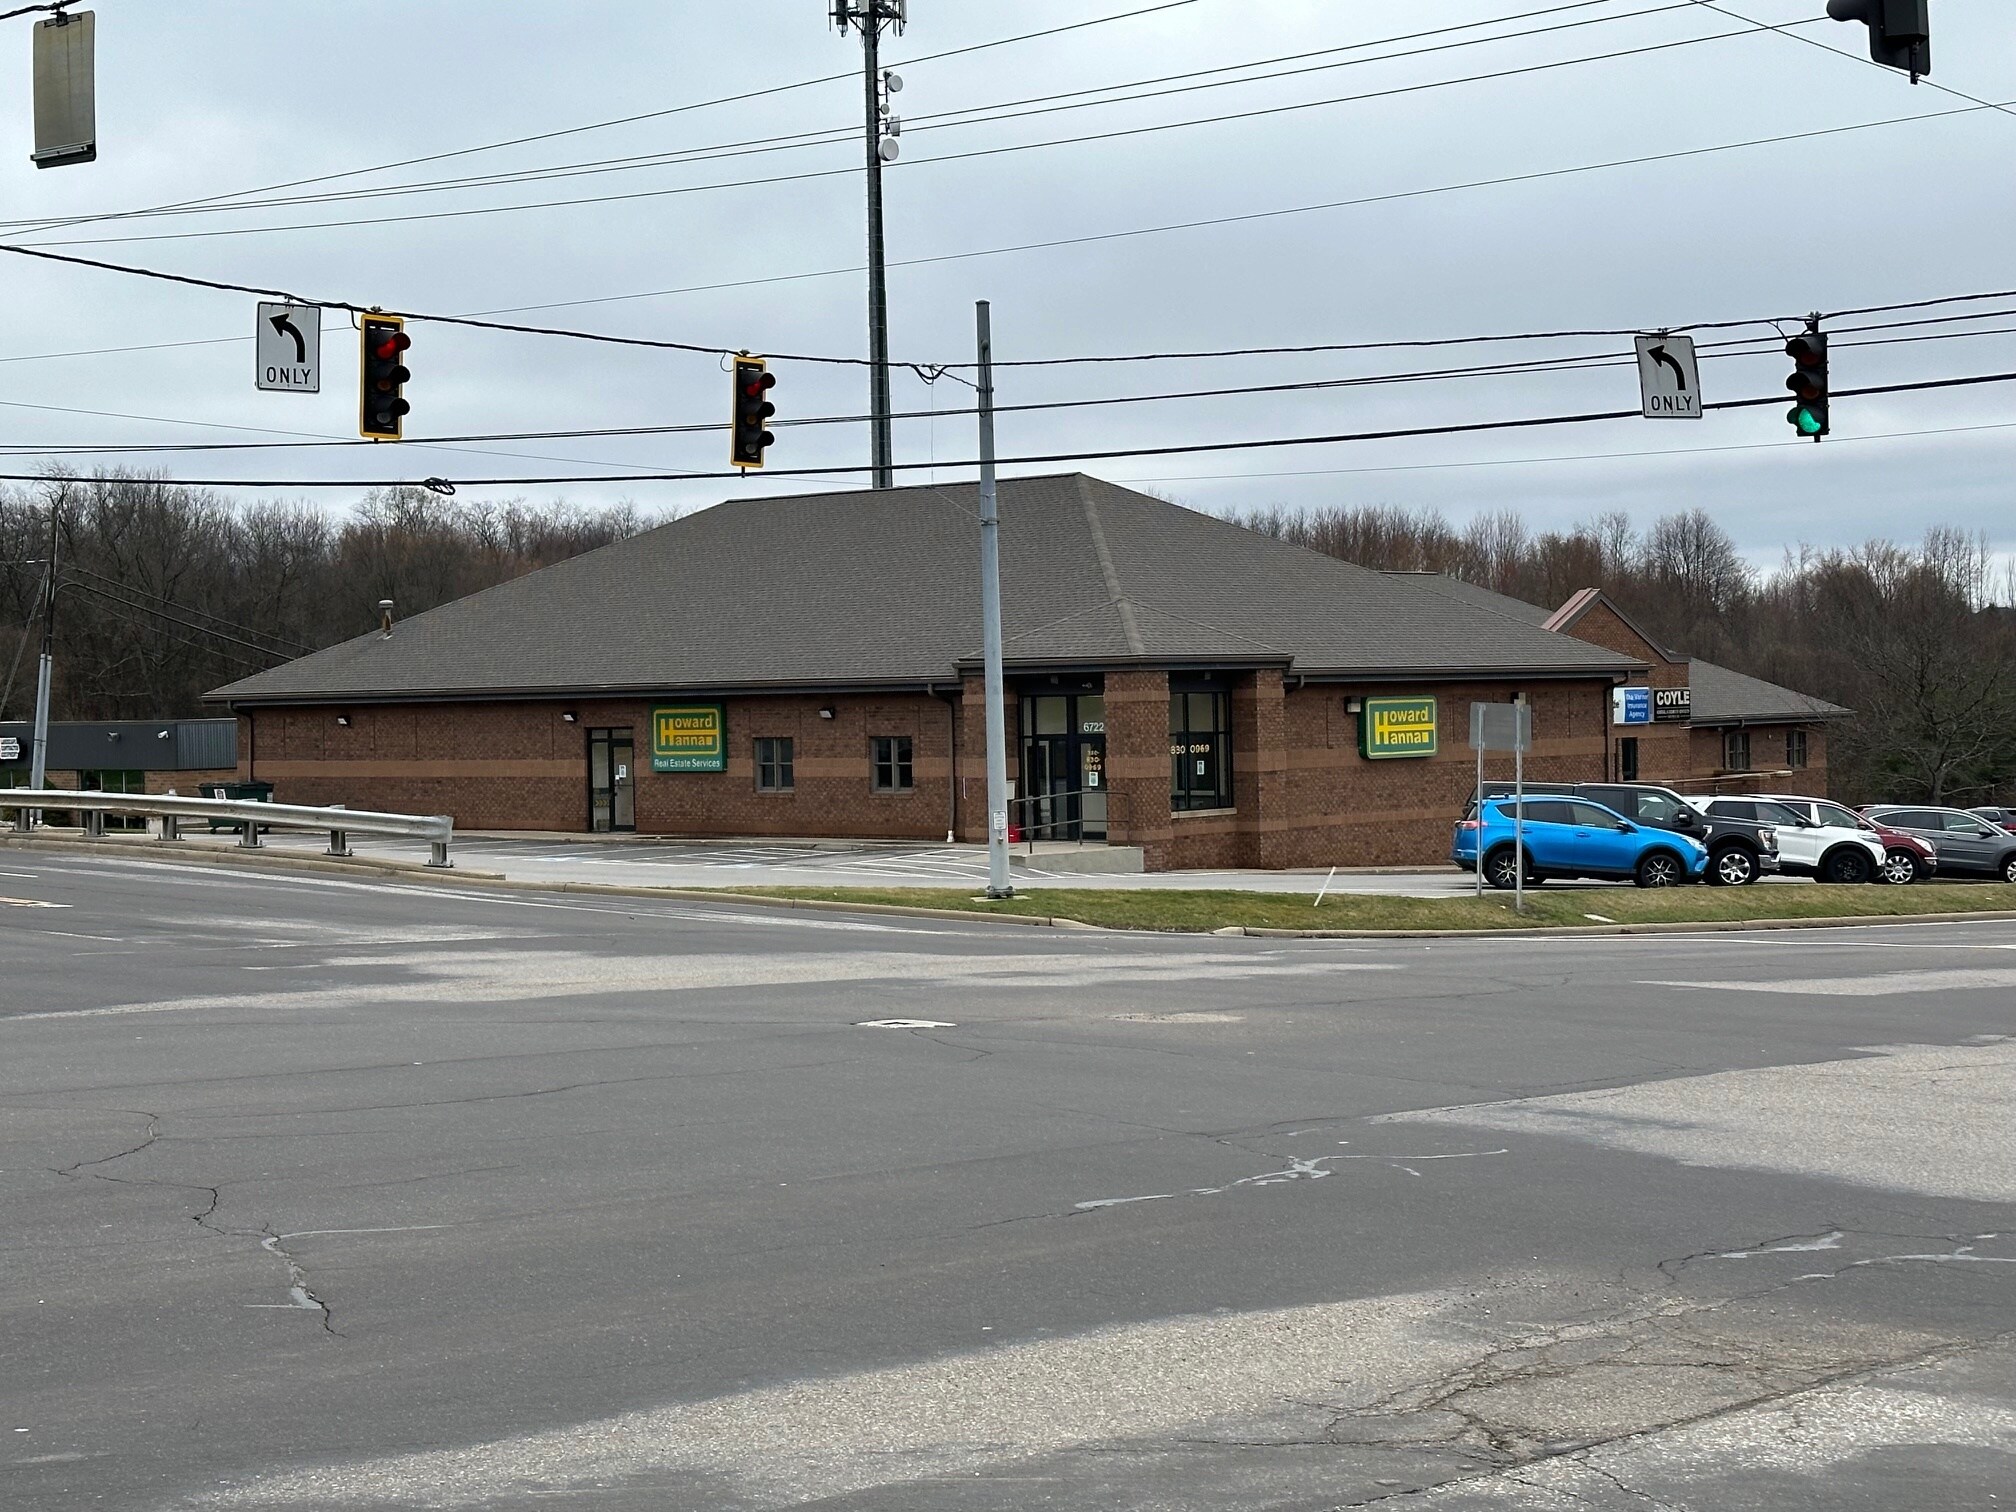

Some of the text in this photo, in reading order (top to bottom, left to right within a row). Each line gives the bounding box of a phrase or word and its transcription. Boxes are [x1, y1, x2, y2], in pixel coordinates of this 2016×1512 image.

[266, 366, 312, 385] ONLY
[1651, 395, 1693, 411] ONLY
[1656, 691, 1690, 706] COYLE
[1374, 706, 1429, 730] Howard
[1629, 711, 1645, 719] Agency
[660, 714, 713, 733] Howard
[1083, 722, 1105, 732] 6722
[660, 729, 706, 747] Hanna
[1374, 724, 1424, 745] Hanna
[1170, 744, 1210, 755] 830 0969
[654, 758, 720, 768] Real Estate Services
